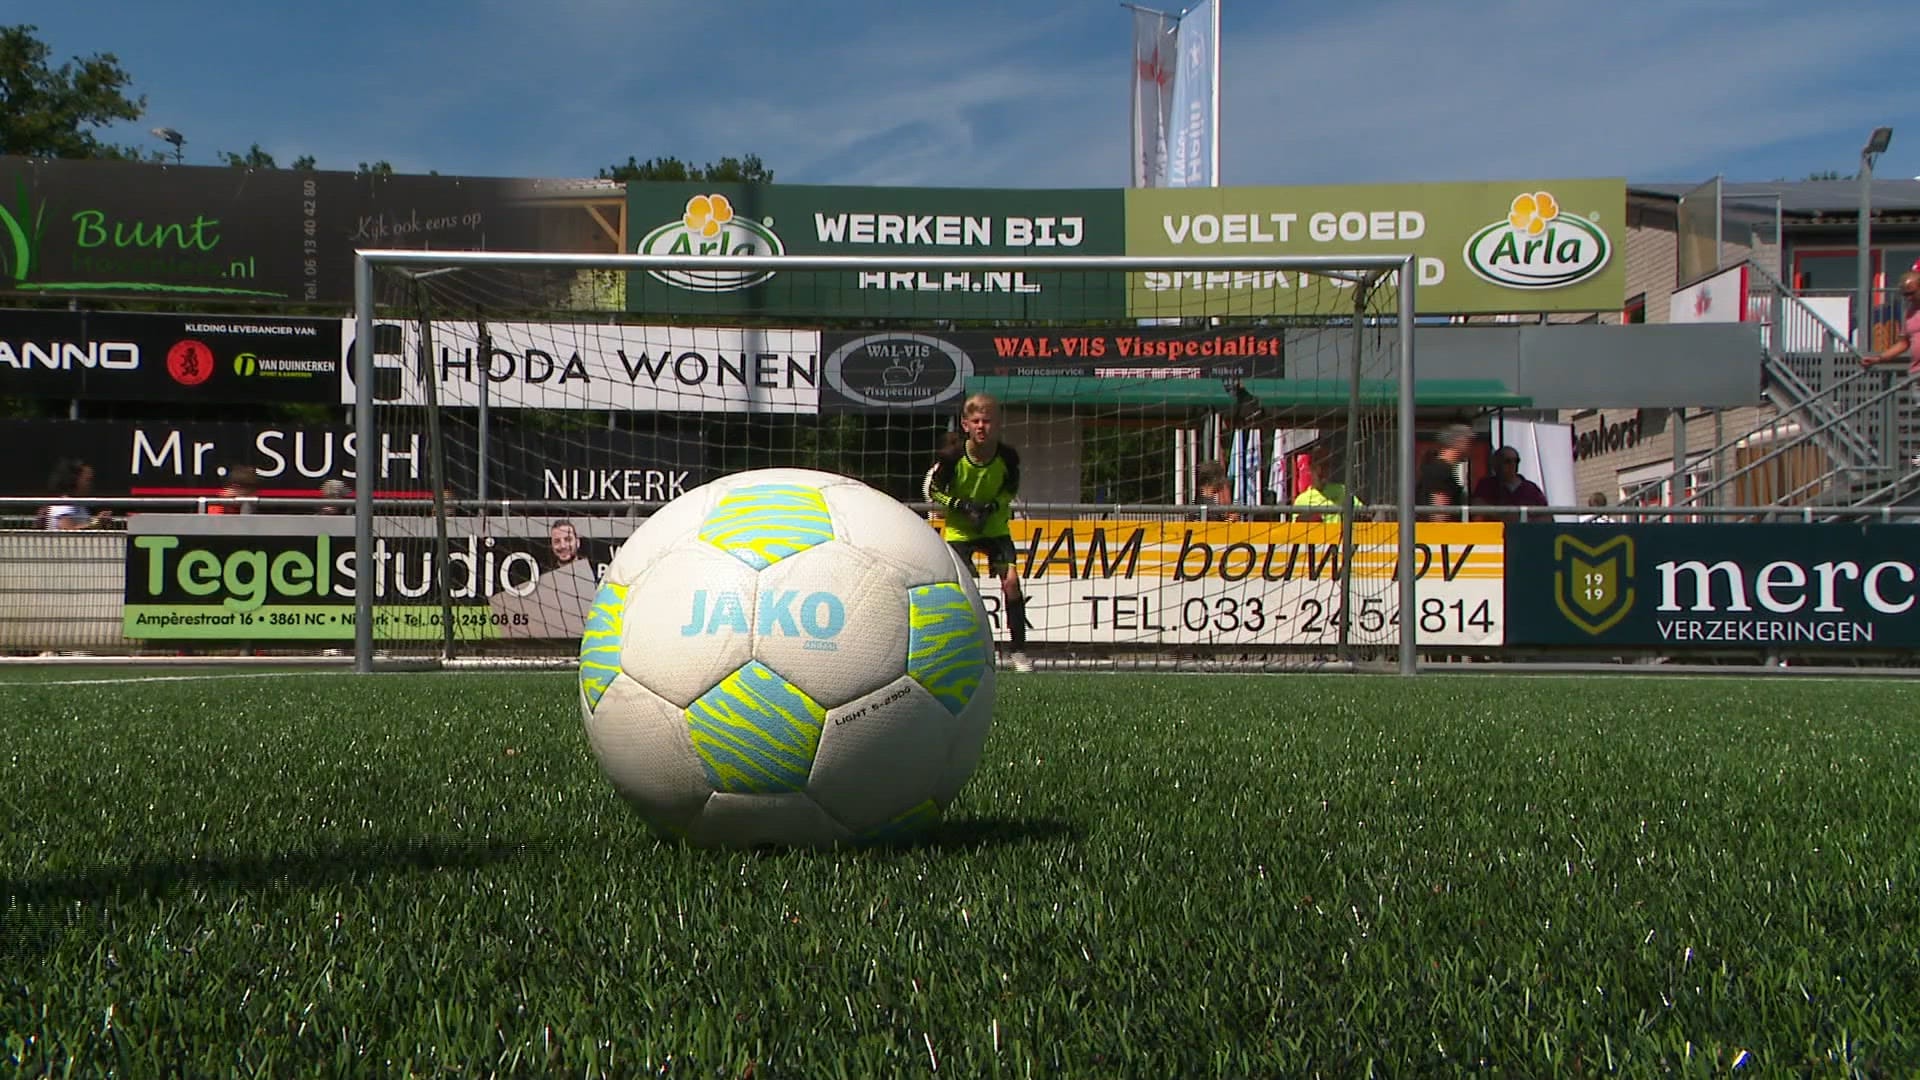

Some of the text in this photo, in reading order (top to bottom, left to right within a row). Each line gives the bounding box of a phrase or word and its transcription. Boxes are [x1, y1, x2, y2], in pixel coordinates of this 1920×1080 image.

[72, 210, 220, 250] Bunt
[350, 213, 389, 243] Kijk
[393, 208, 420, 234] ook
[425, 214, 458, 231] eens
[462, 211, 481, 231] op
[815, 212, 1084, 247] WERKEN BIJ
[1163, 211, 1426, 244] VOELT GOED
[304, 180, 317, 301] Tel. 06 13 40 42 80
[668, 230, 756, 256] Arla
[1489, 228, 1582, 265] Arla
[185, 323, 317, 336] KLEDING LEVERANCIER VAN:
[866, 344, 931, 357] WAL-VIS
[994, 335, 1281, 360] WAL-VIS Visspecialist
[258, 359, 335, 372] VAN DUINKERKEN
[442, 347, 816, 388] HODA WONEN
[864, 386, 931, 397] Visspecialist
[131, 429, 227, 476] Mr.
[543, 469, 690, 500] NIJKERK
[1584, 573, 1604, 585] 19
[1656, 560, 1915, 613] merc
[1584, 588, 1604, 601] 19
[136, 612, 236, 628] Ampèrestraat
[239, 613, 254, 625] 16
[269, 613, 301, 625] 3861
[305, 613, 326, 625] NC
[341, 613, 389, 627] Nirk
[405, 613, 426, 627] Tel.
[462, 613, 486, 627] 245
[491, 613, 509, 626] 08
[512, 613, 529, 625] 85
[681, 590, 845, 640] JAKO
[1656, 620, 1873, 642] VERZEKERINGEN
[835, 708, 867, 726] LIGHT
